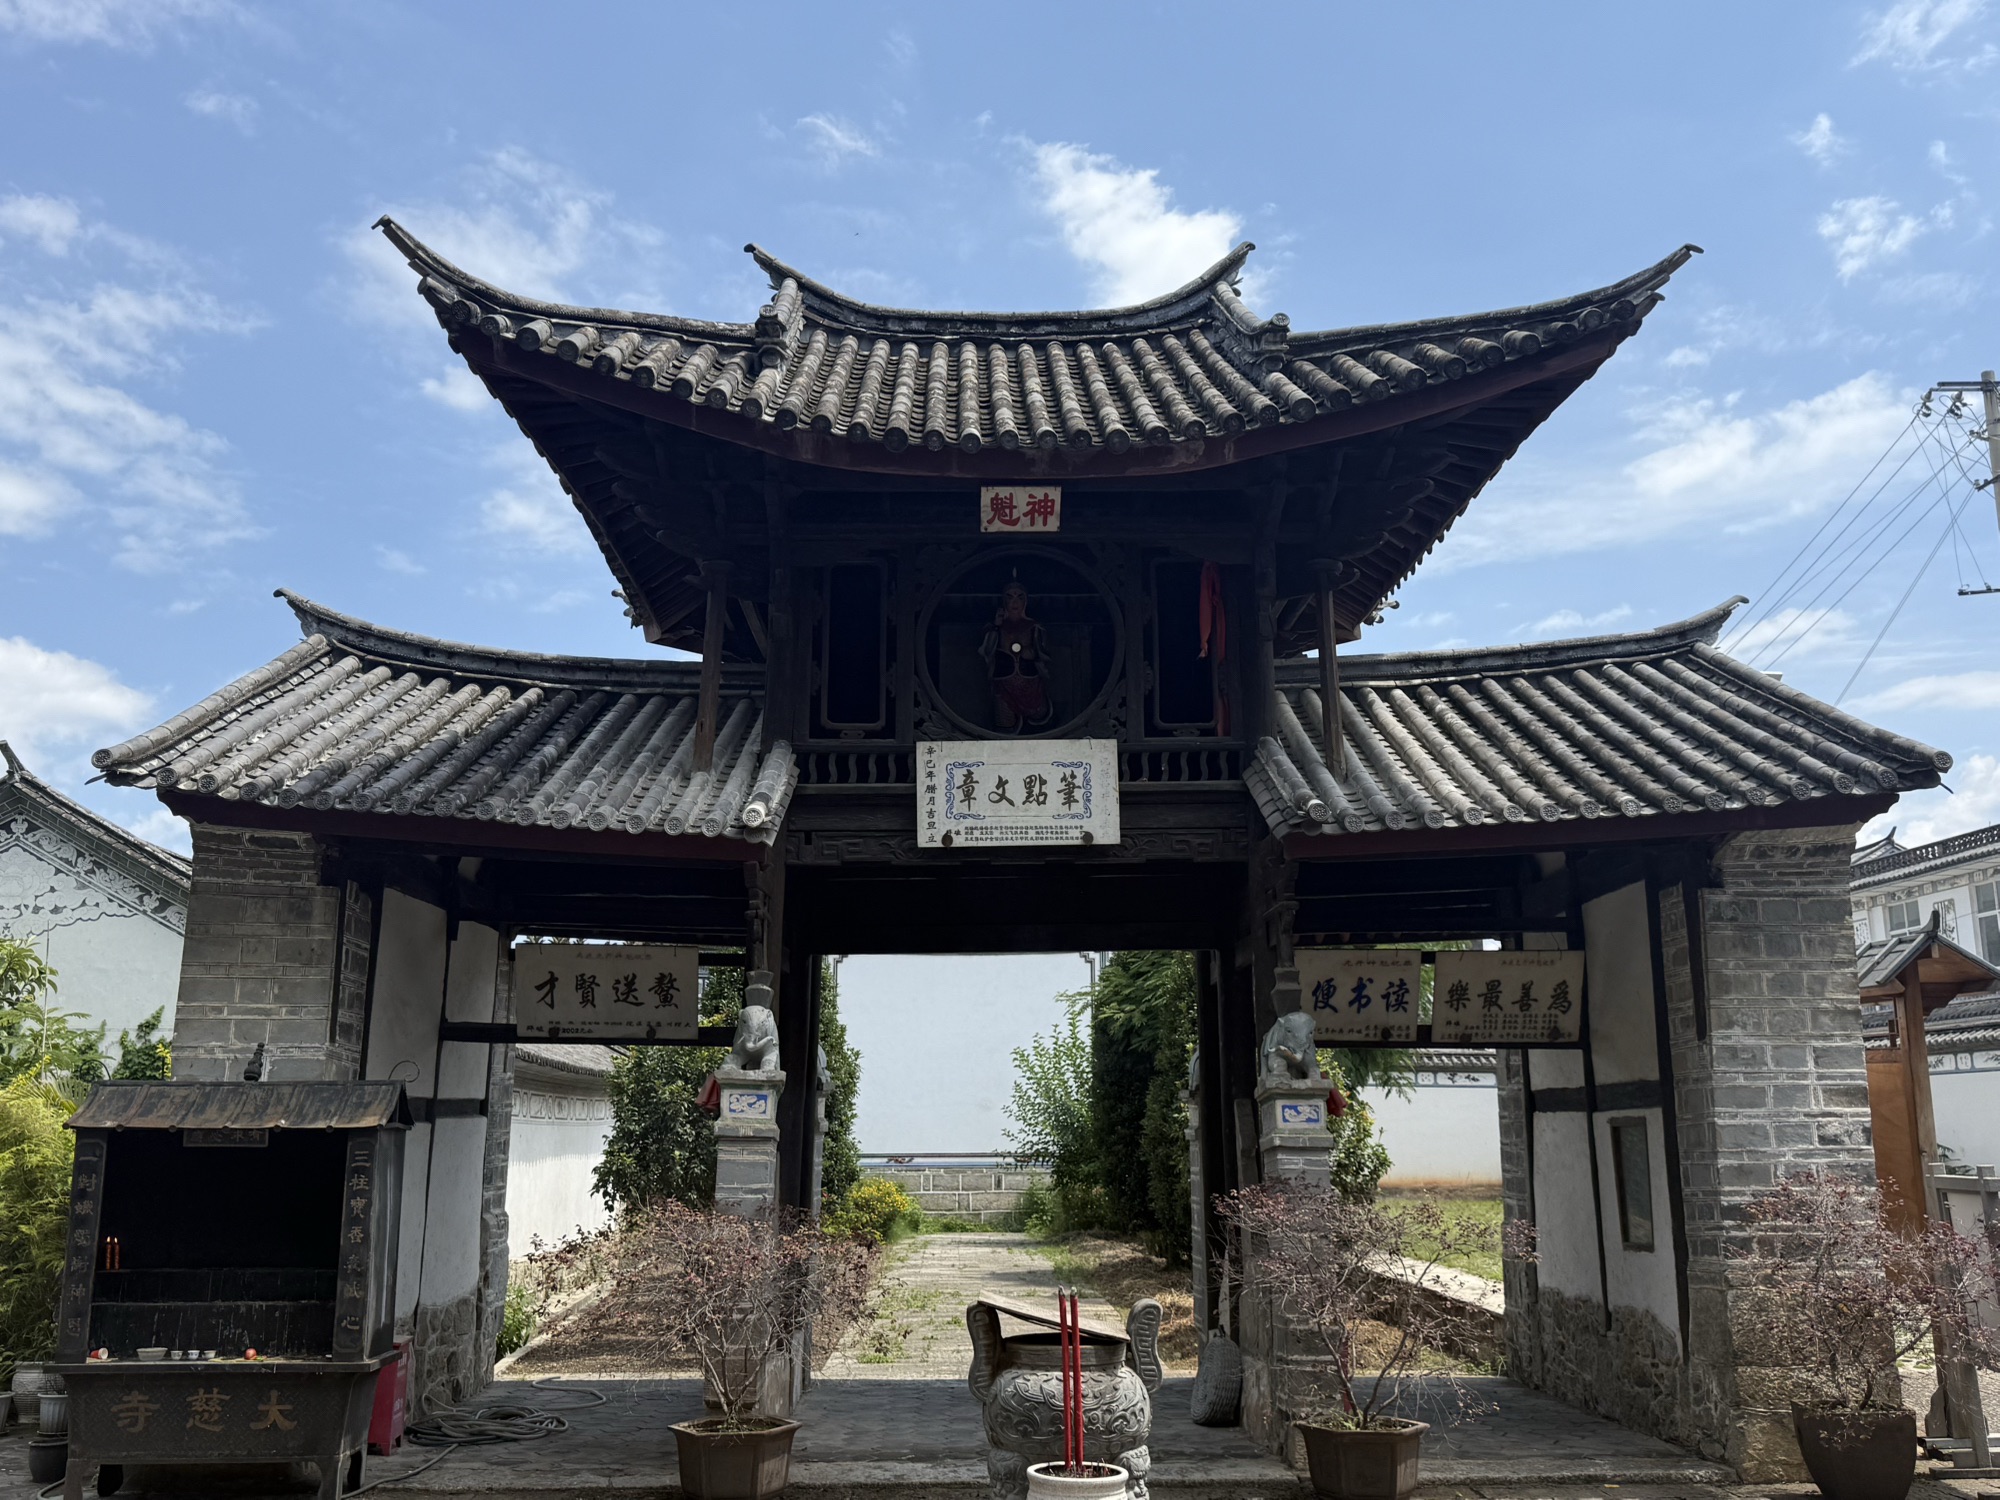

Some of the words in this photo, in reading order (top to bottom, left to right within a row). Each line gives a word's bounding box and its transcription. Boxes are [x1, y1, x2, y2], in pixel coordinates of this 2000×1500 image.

[1311, 976, 1411, 1014] 读书便
[110, 1387, 298, 1433] 大慈寺
